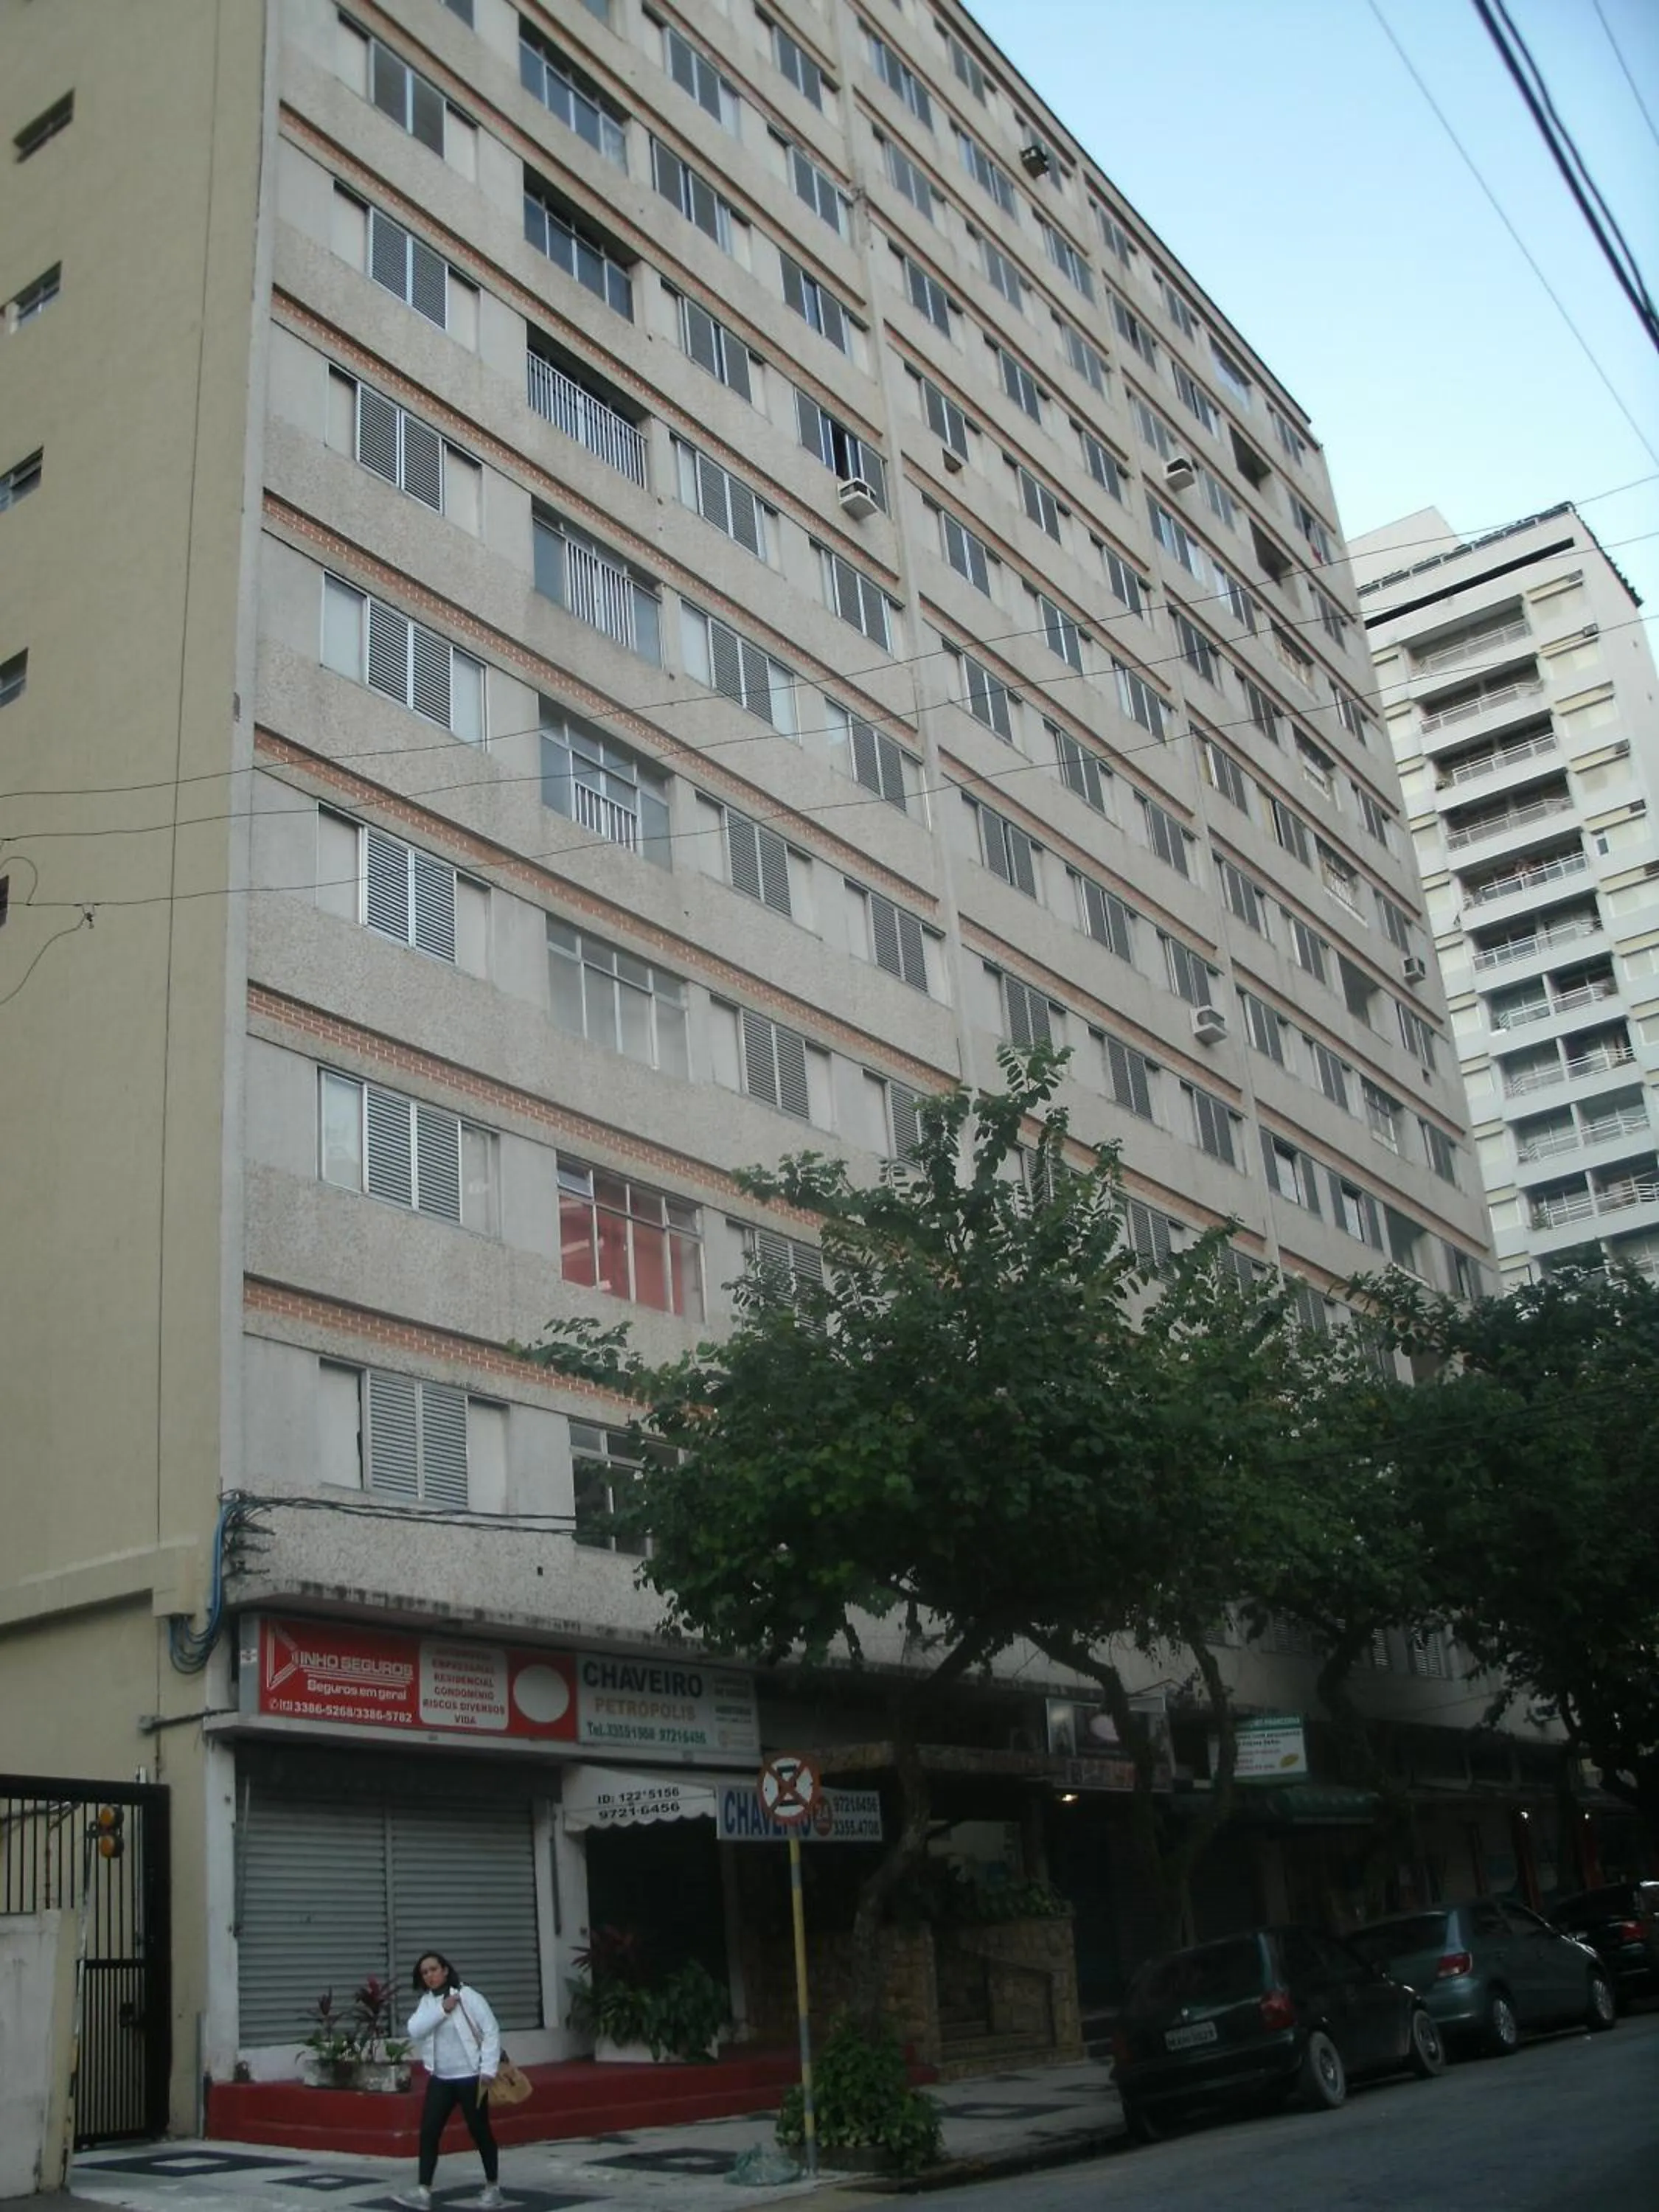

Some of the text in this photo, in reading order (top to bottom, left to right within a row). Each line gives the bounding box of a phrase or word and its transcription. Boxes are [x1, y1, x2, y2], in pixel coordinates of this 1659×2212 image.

[340, 1655, 413, 1677] SEGUROS
[434, 1673, 494, 1687] RESIDENCIAL
[583, 1660, 702, 1697] CHAVEIRO
[307, 1679, 407, 1701] Seguros em geral
[422, 1698, 505, 1715] RISCOS DIVERSOS
[454, 1714, 476, 1724] VIDA
[598, 1794, 614, 1804] ID:
